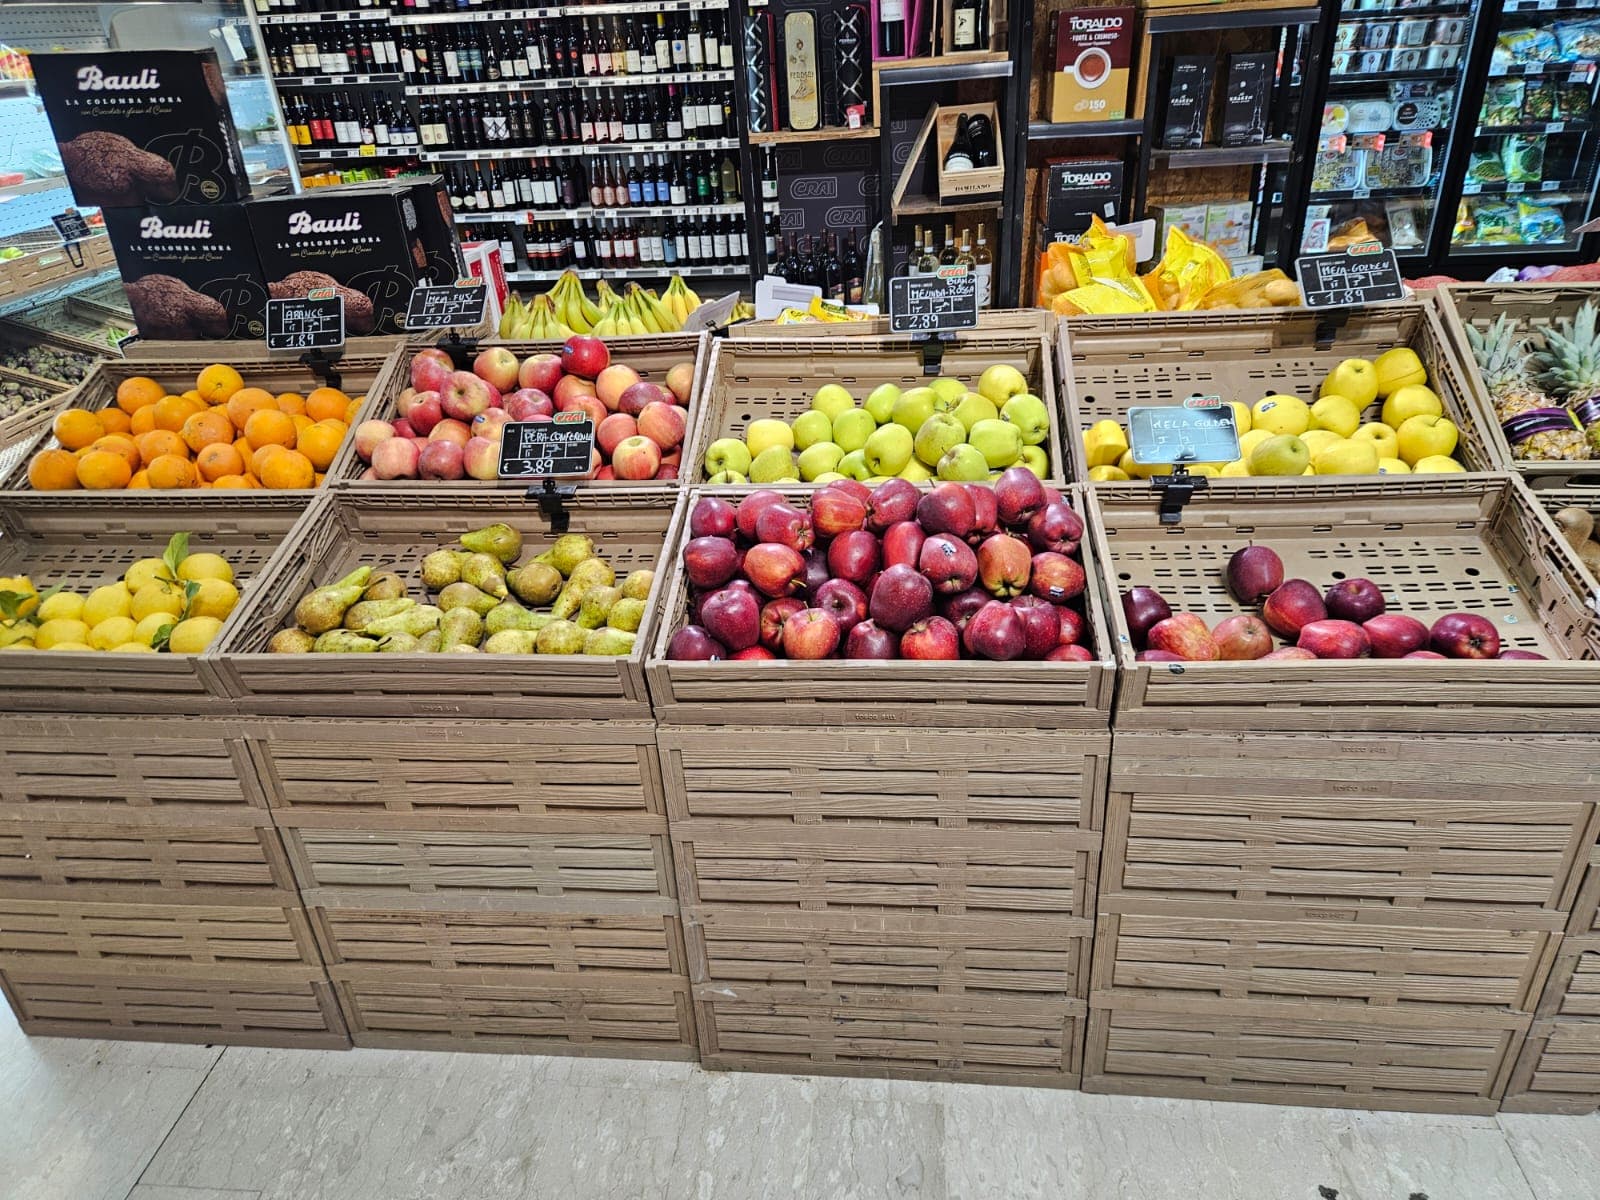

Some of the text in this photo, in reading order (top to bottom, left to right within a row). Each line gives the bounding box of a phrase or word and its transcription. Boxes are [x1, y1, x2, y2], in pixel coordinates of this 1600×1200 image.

[1070, 17, 1123, 30] TORALDO
[76, 65, 161, 91] Bauli
[86, 97, 143, 105] COLOMBA
[1088, 98, 1106, 110] 150
[1061, 171, 1112, 184] TORALDO
[792, 180, 836, 197] CRAI
[140, 215, 213, 239] Bauli
[288, 210, 362, 235] Bauli
[939, 268, 965, 277] CRAI
